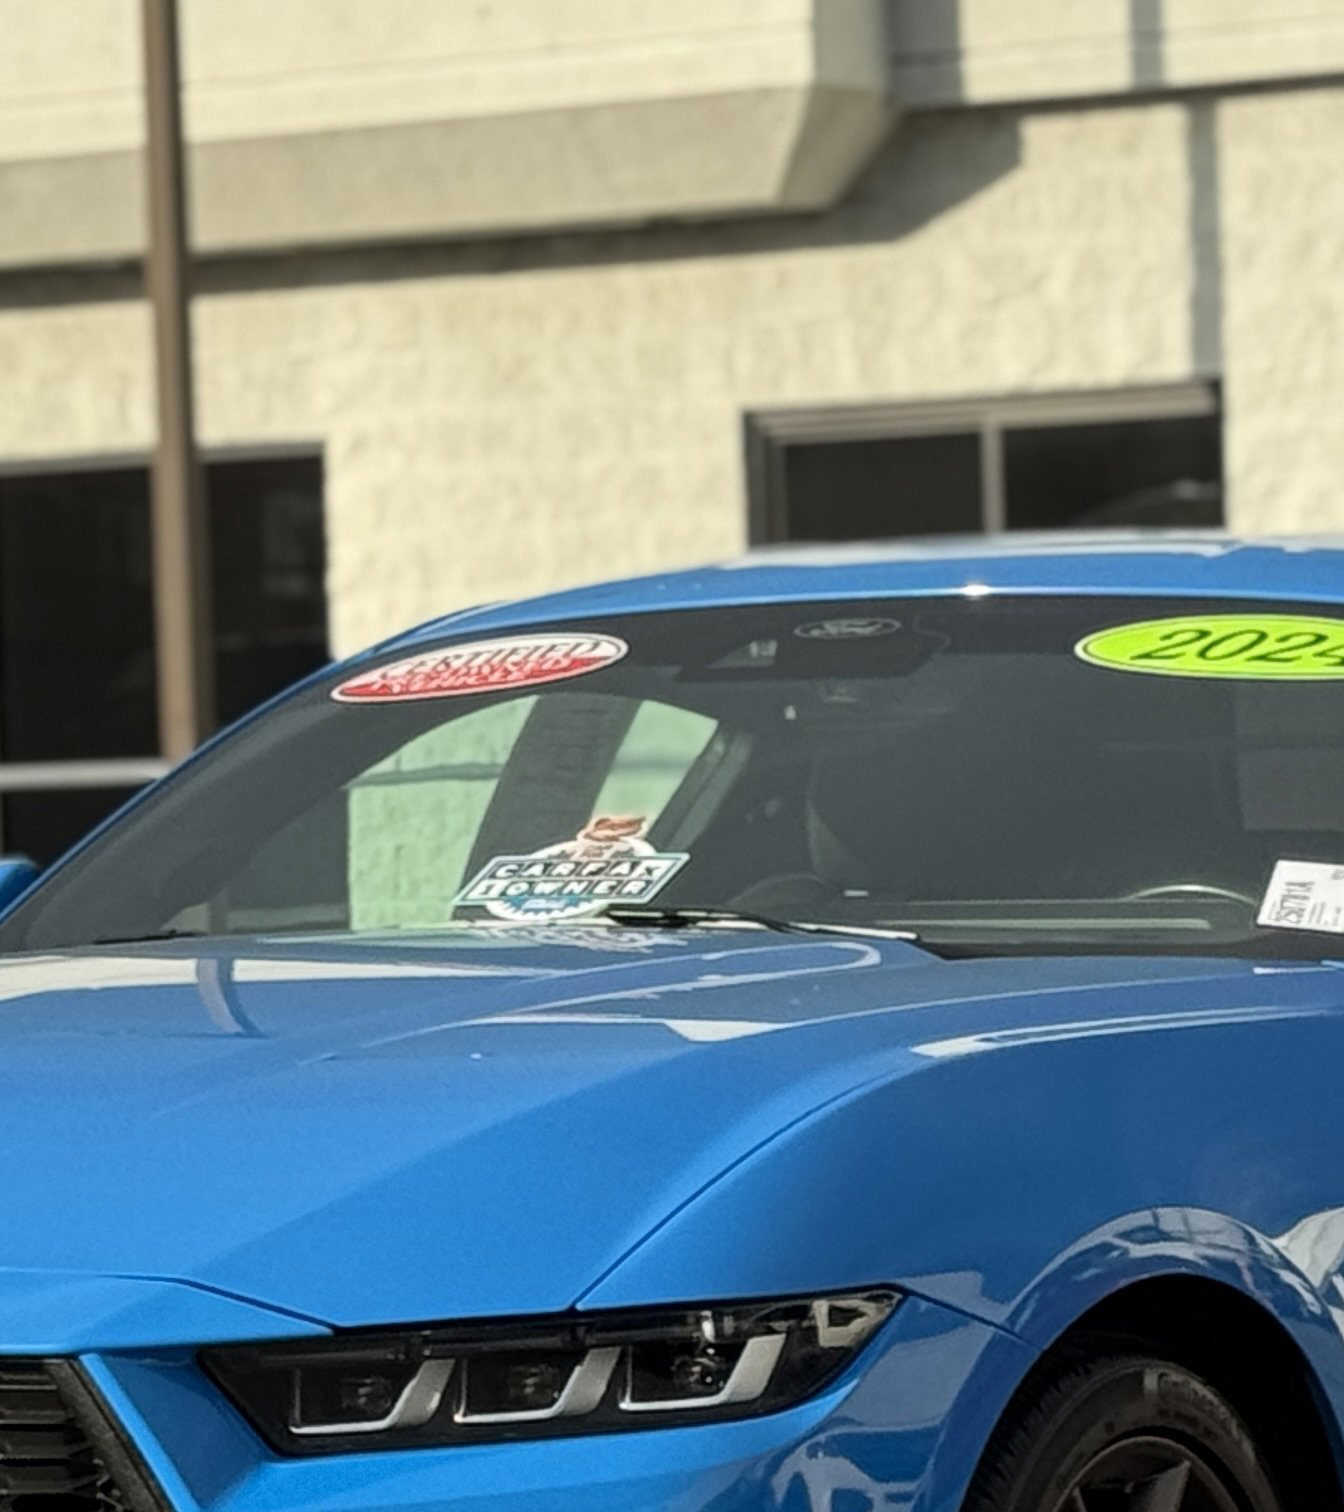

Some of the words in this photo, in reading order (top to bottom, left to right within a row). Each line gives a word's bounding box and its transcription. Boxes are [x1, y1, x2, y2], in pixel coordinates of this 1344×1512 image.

[378, 640, 602, 681] CERTIFIED
[492, 860, 661, 878] CARFAX
[504, 880, 648, 896] OWNER
